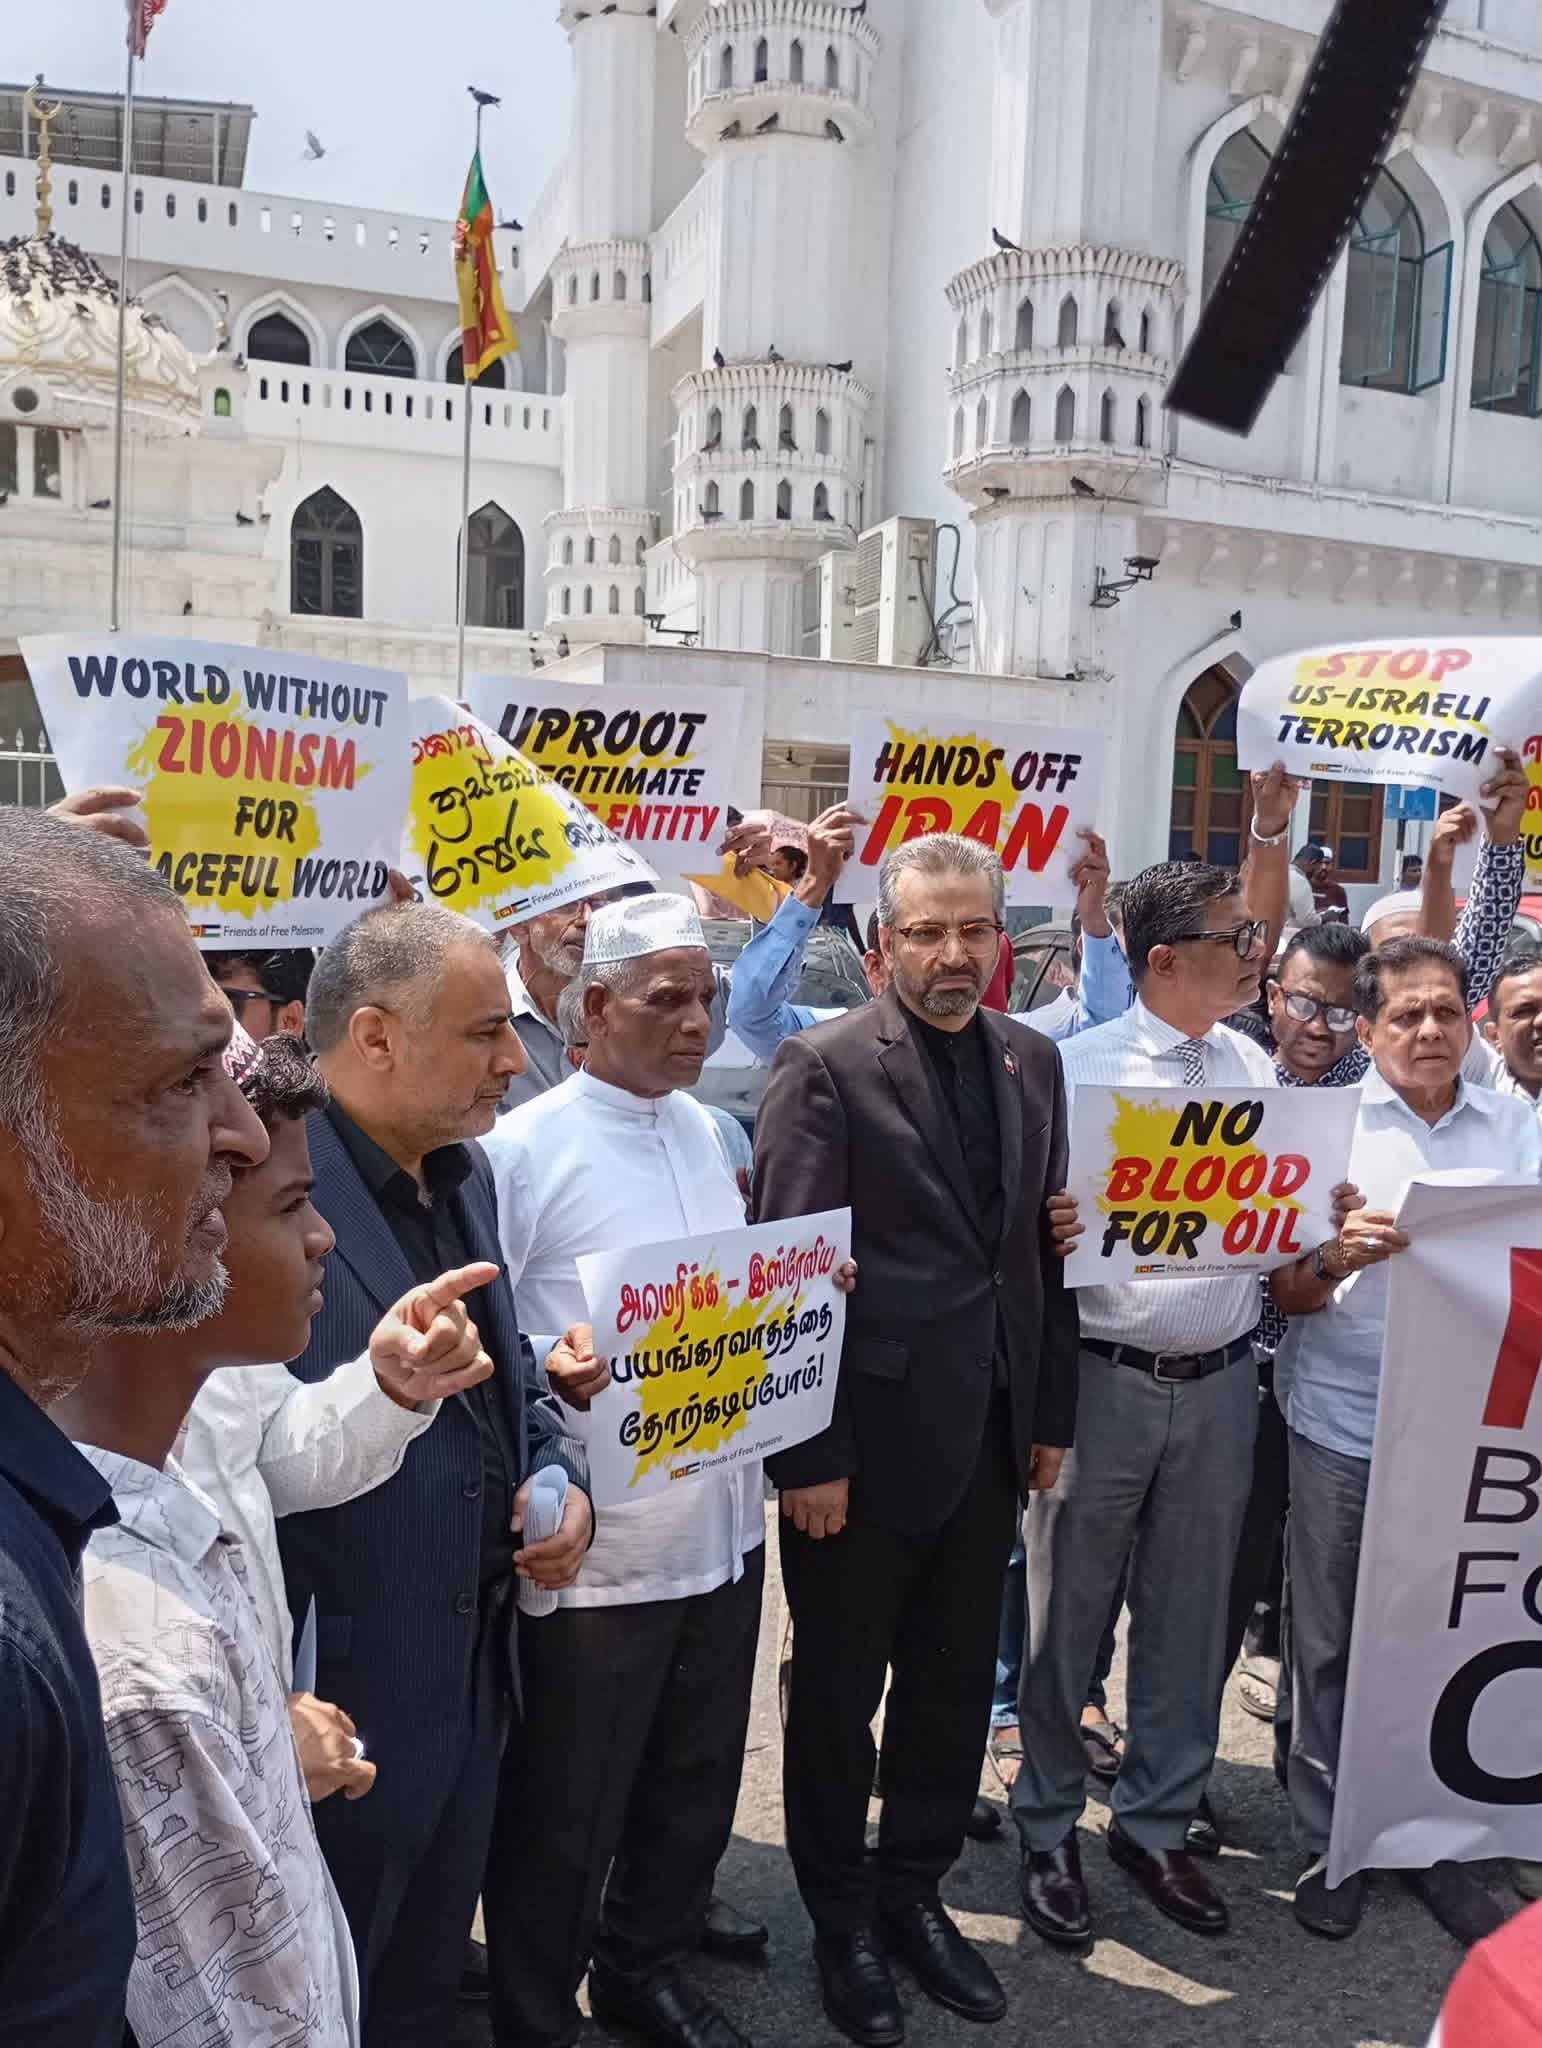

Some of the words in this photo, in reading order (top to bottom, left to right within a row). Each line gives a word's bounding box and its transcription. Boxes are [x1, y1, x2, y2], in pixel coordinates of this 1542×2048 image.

[1314, 648, 1473, 682] STOP
[68, 655, 231, 706] WORLD
[243, 669, 389, 728] WITHOUT
[1288, 684, 1492, 723] US-ISRAELI
[156, 715, 357, 791] ZIONISM
[499, 703, 708, 759] UPROOT
[1276, 714, 1490, 766] TERRORISM
[873, 741, 1005, 789] HANDS
[1011, 750, 1082, 794] OFF
[234, 796, 299, 844] FOR
[606, 803, 721, 842] ENTITY
[148, 850, 281, 899] ACEFUL
[292, 857, 390, 902] WORLD
[223, 924, 257, 937] Friends
[259, 924, 270, 937] of
[270, 925, 289, 937] Free
[1169, 1099, 1265, 1147] NO
[1105, 1153, 1312, 1203] BLOOD
[1100, 1209, 1208, 1260] FOR
[1221, 1207, 1302, 1256] OIL
[616, 1262, 719, 1334] அமெரிக்க
[748, 1234, 837, 1302] இஸ்ரேலிய
[1165, 1262, 1194, 1274] Friends
[1194, 1262, 1205, 1273] of
[1206, 1262, 1224, 1273] Free
[701, 1455, 728, 1471] Friends
[729, 1452, 738, 1465] of
